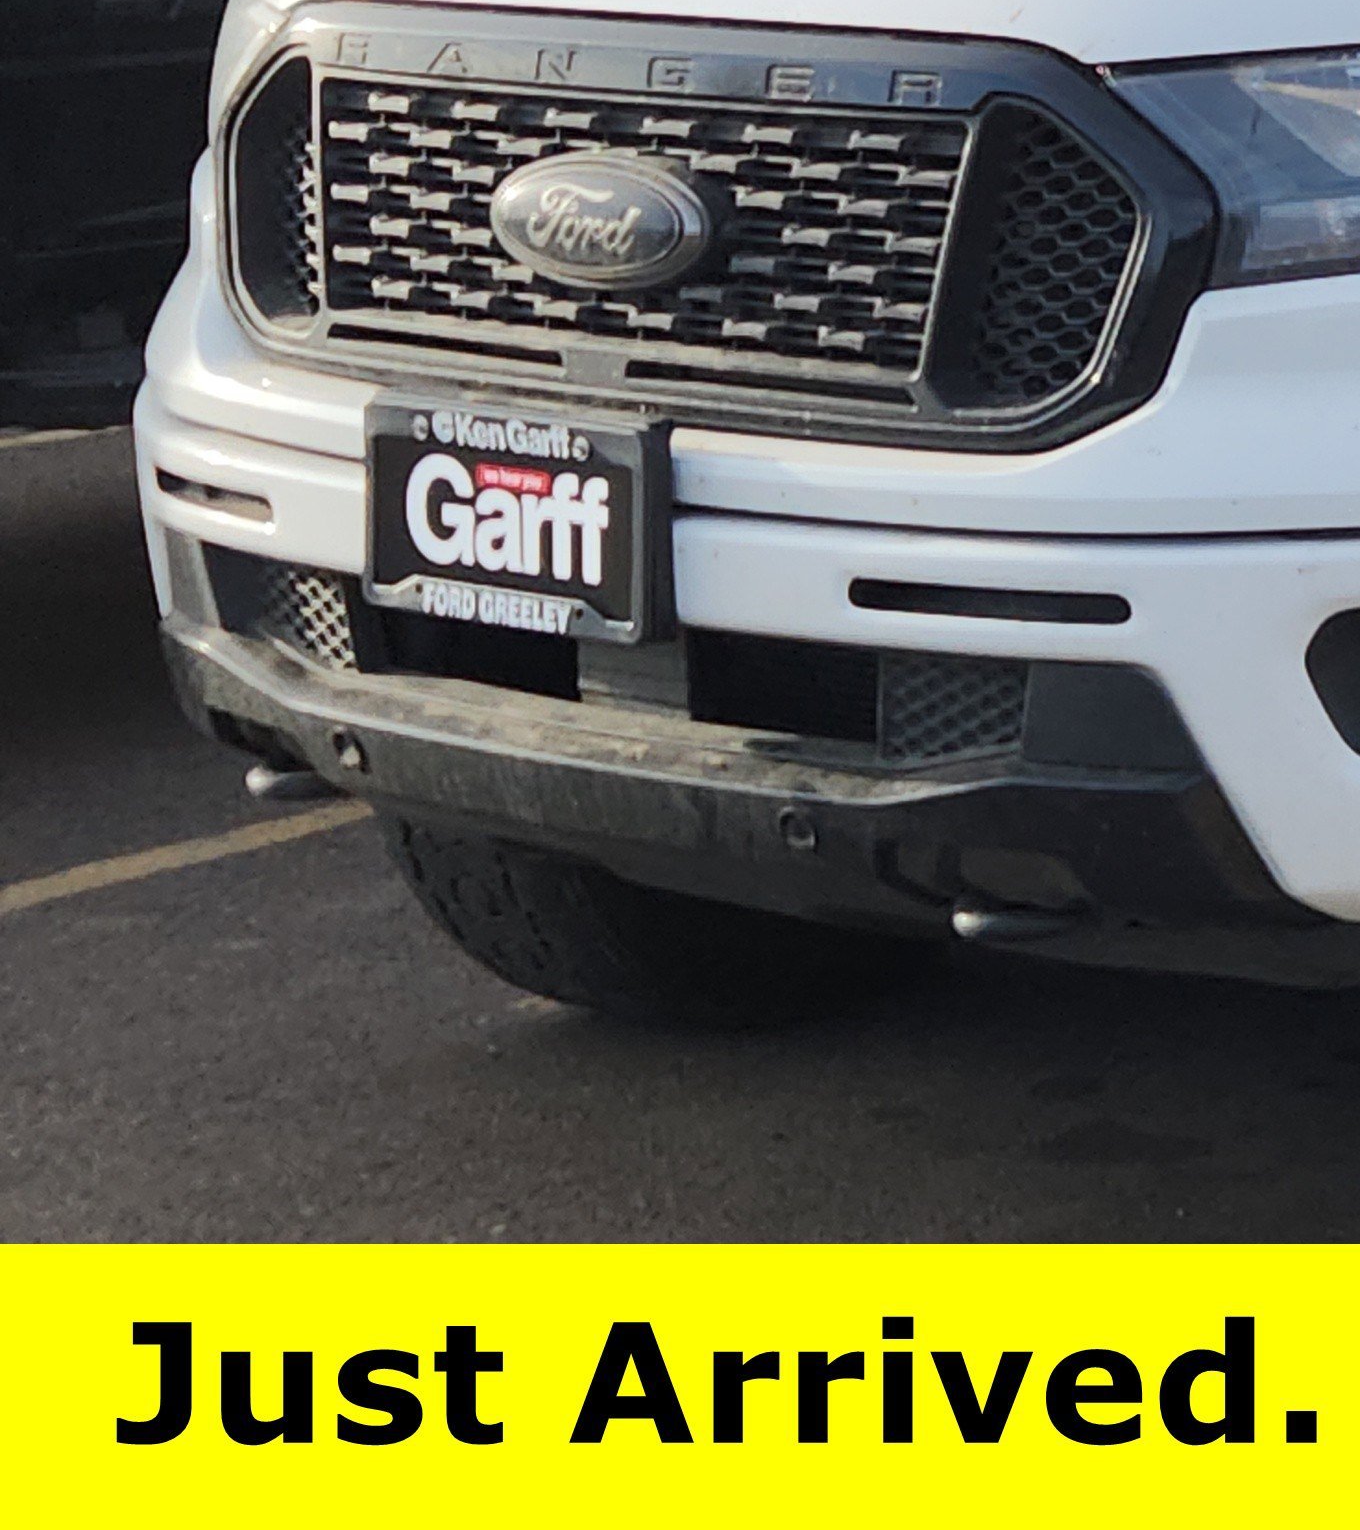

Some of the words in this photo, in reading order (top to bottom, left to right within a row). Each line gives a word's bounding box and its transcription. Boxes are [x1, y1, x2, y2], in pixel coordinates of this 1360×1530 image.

[335, 31, 943, 107] RANGER
[526, 183, 641, 256] Ford
[406, 452, 609, 586] Garff
[421, 582, 476, 620] FORD
[477, 590, 572, 635] GREELEY
